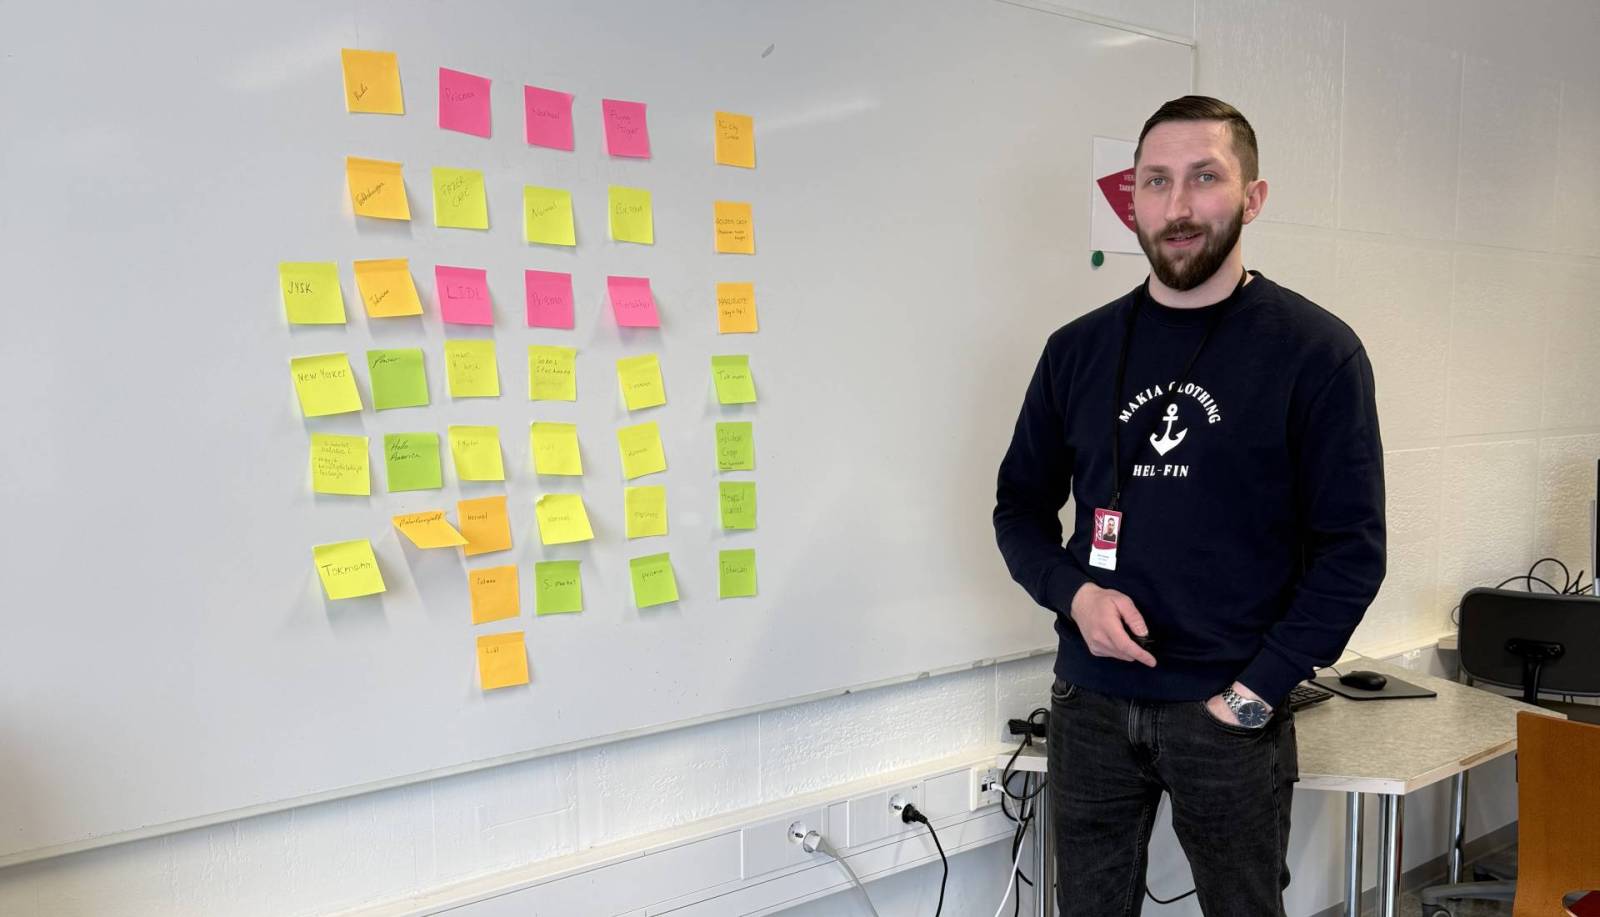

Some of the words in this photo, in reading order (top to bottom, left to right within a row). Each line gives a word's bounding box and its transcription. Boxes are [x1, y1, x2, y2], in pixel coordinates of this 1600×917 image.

[288, 280, 313, 295] JYSK
[1118, 384, 1163, 424] MAKIA
[1132, 463, 1190, 478] HEL-FIN
